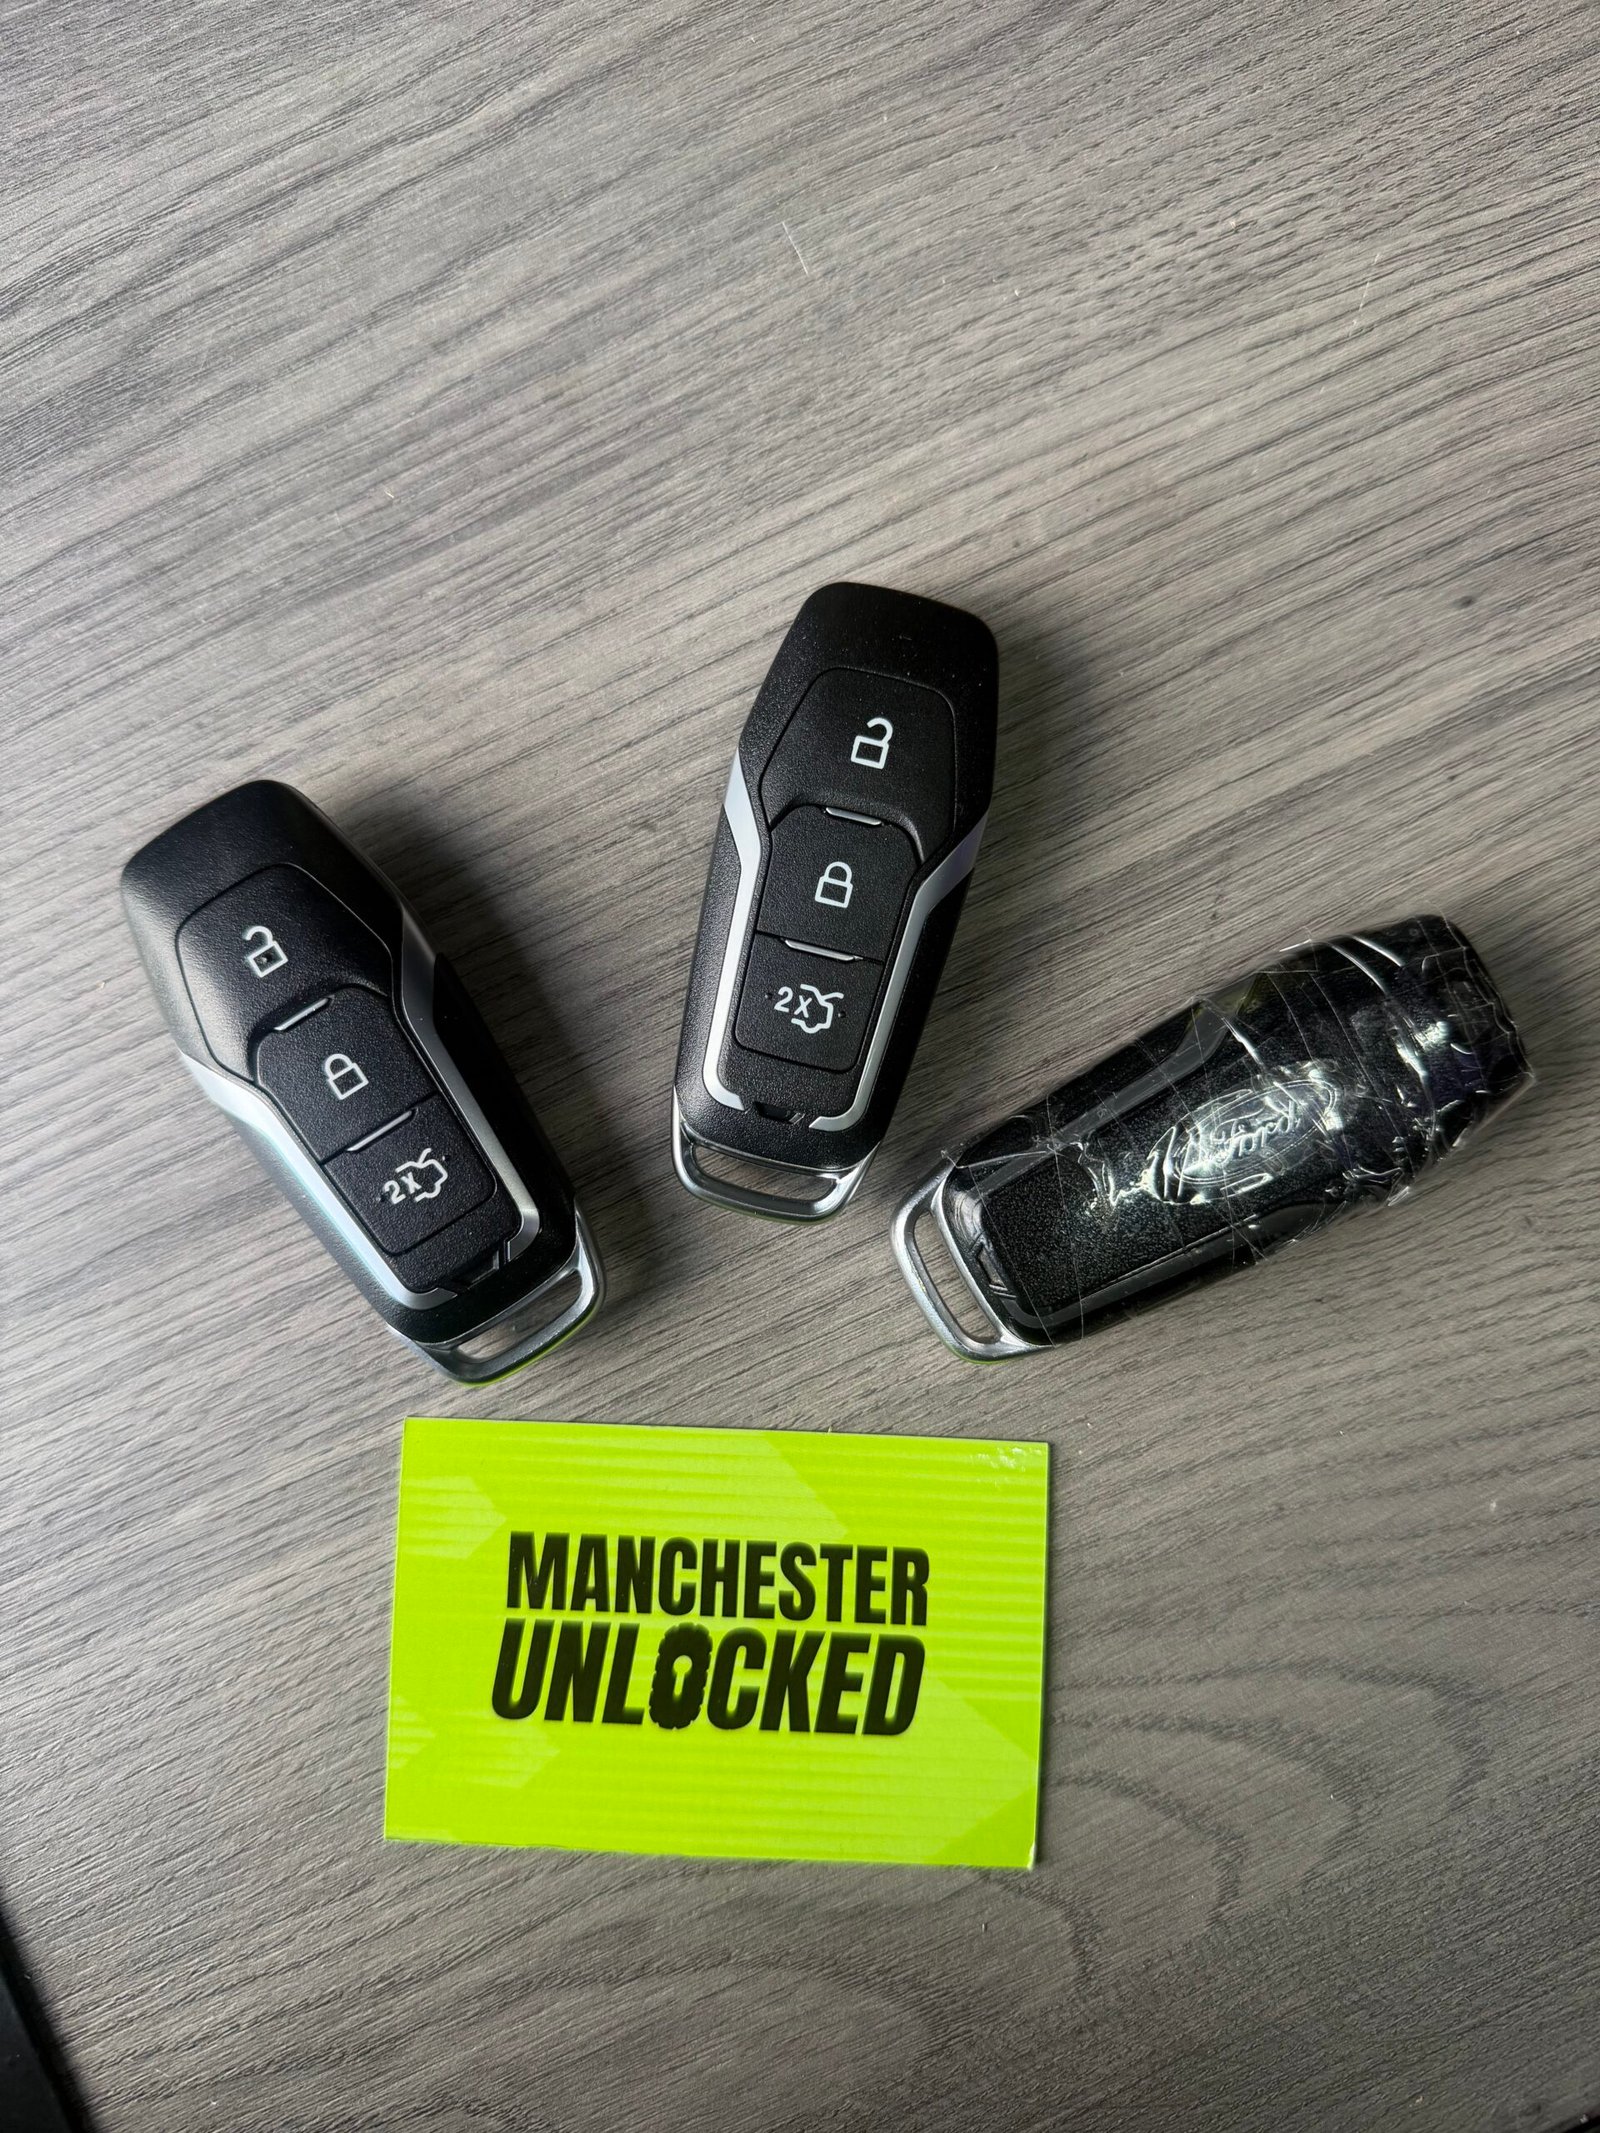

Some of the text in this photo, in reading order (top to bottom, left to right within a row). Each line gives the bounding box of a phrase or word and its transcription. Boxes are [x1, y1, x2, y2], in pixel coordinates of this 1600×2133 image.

[1205, 1098, 1302, 1166] Ford
[505, 1532, 931, 1627] MANCHESTER
[490, 1619, 927, 1737] UNLOCKED
